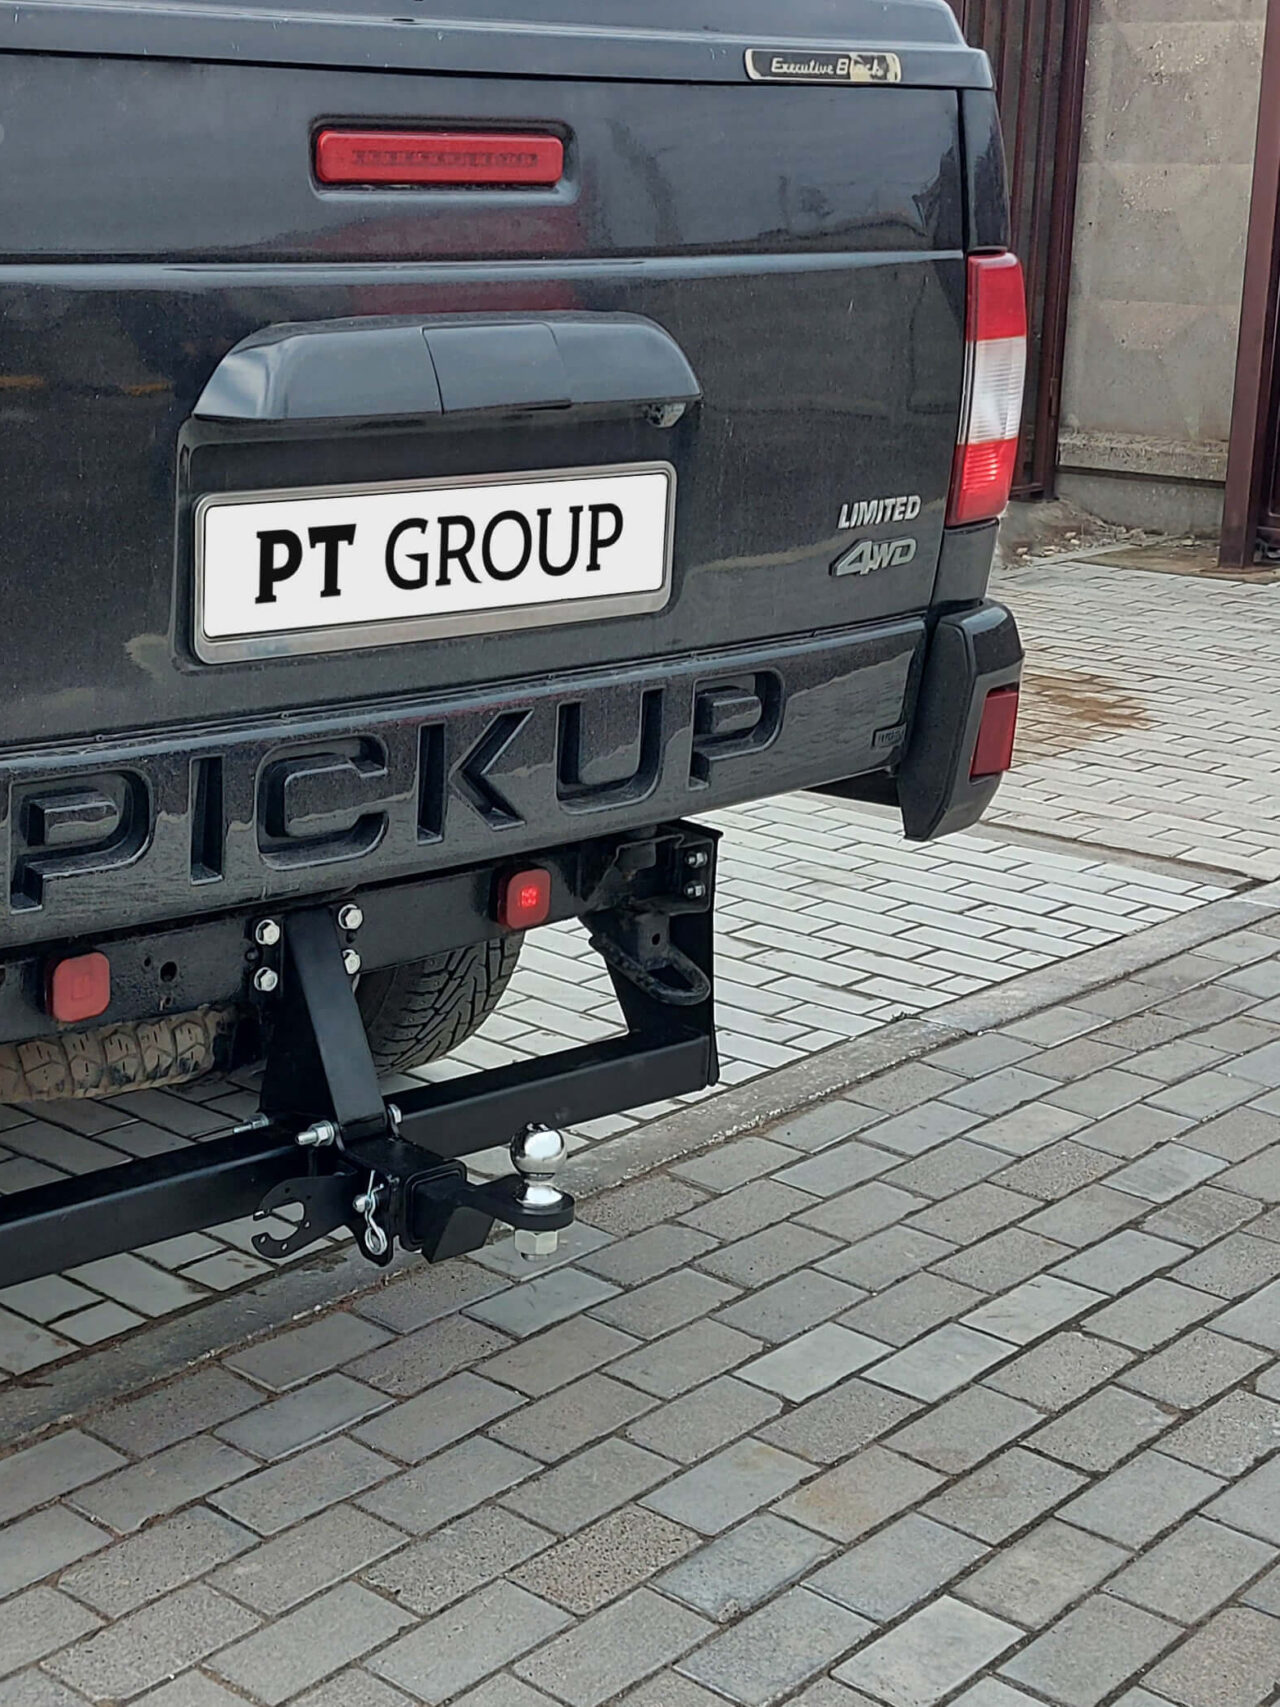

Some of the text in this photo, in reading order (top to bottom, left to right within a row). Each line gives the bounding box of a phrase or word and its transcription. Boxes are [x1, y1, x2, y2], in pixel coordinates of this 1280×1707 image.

[771, 57, 834, 75] Executive
[838, 494, 921, 529] LIMITED
[254, 502, 624, 604] PT GROUP
[835, 538, 917, 576] 4WD
[9, 669, 785, 914] PICKUP
